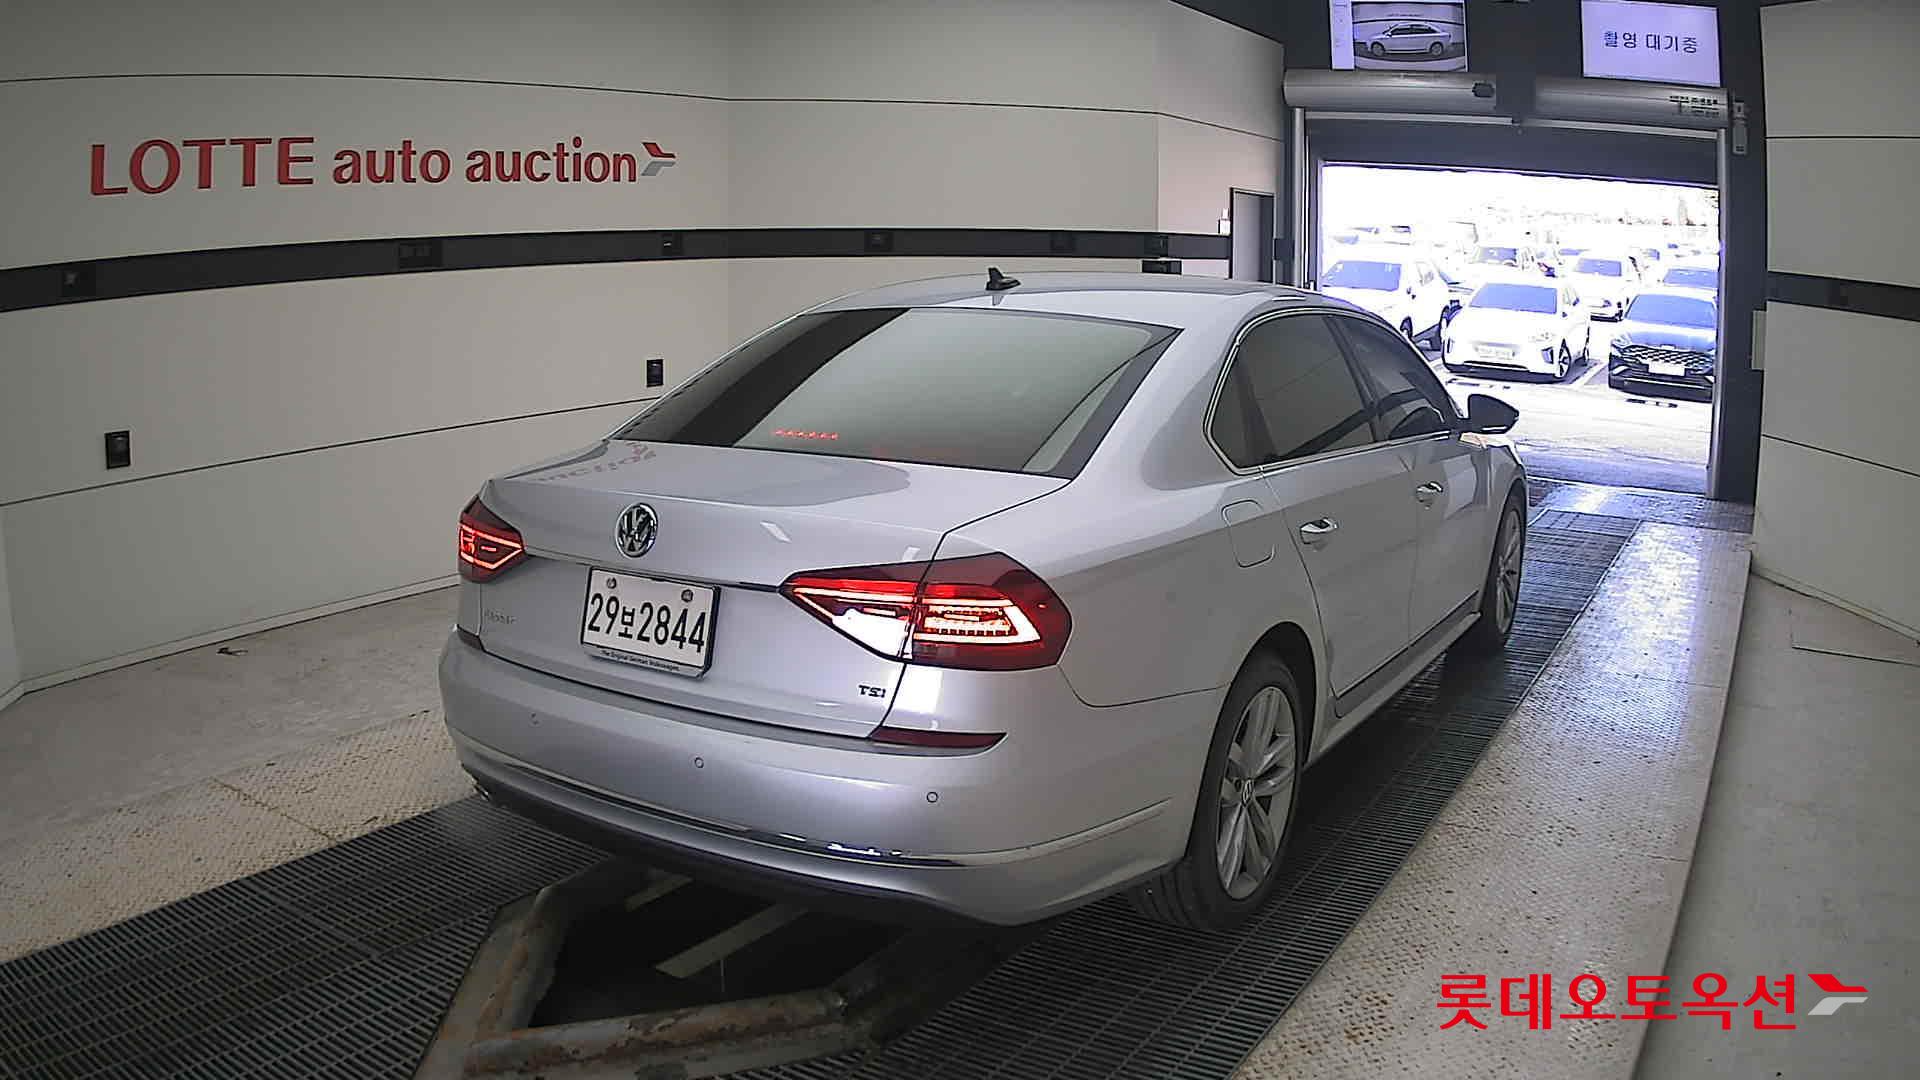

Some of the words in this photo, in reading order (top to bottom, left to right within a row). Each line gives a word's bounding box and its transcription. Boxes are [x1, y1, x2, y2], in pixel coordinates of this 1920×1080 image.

[1646, 33, 1697, 53] 대기중
[90, 137, 315, 196] LOTTE
[332, 139, 452, 184] auto
[465, 136, 638, 184] auction
[587, 592, 706, 653] 29보2844
[858, 684, 886, 698] TSI
